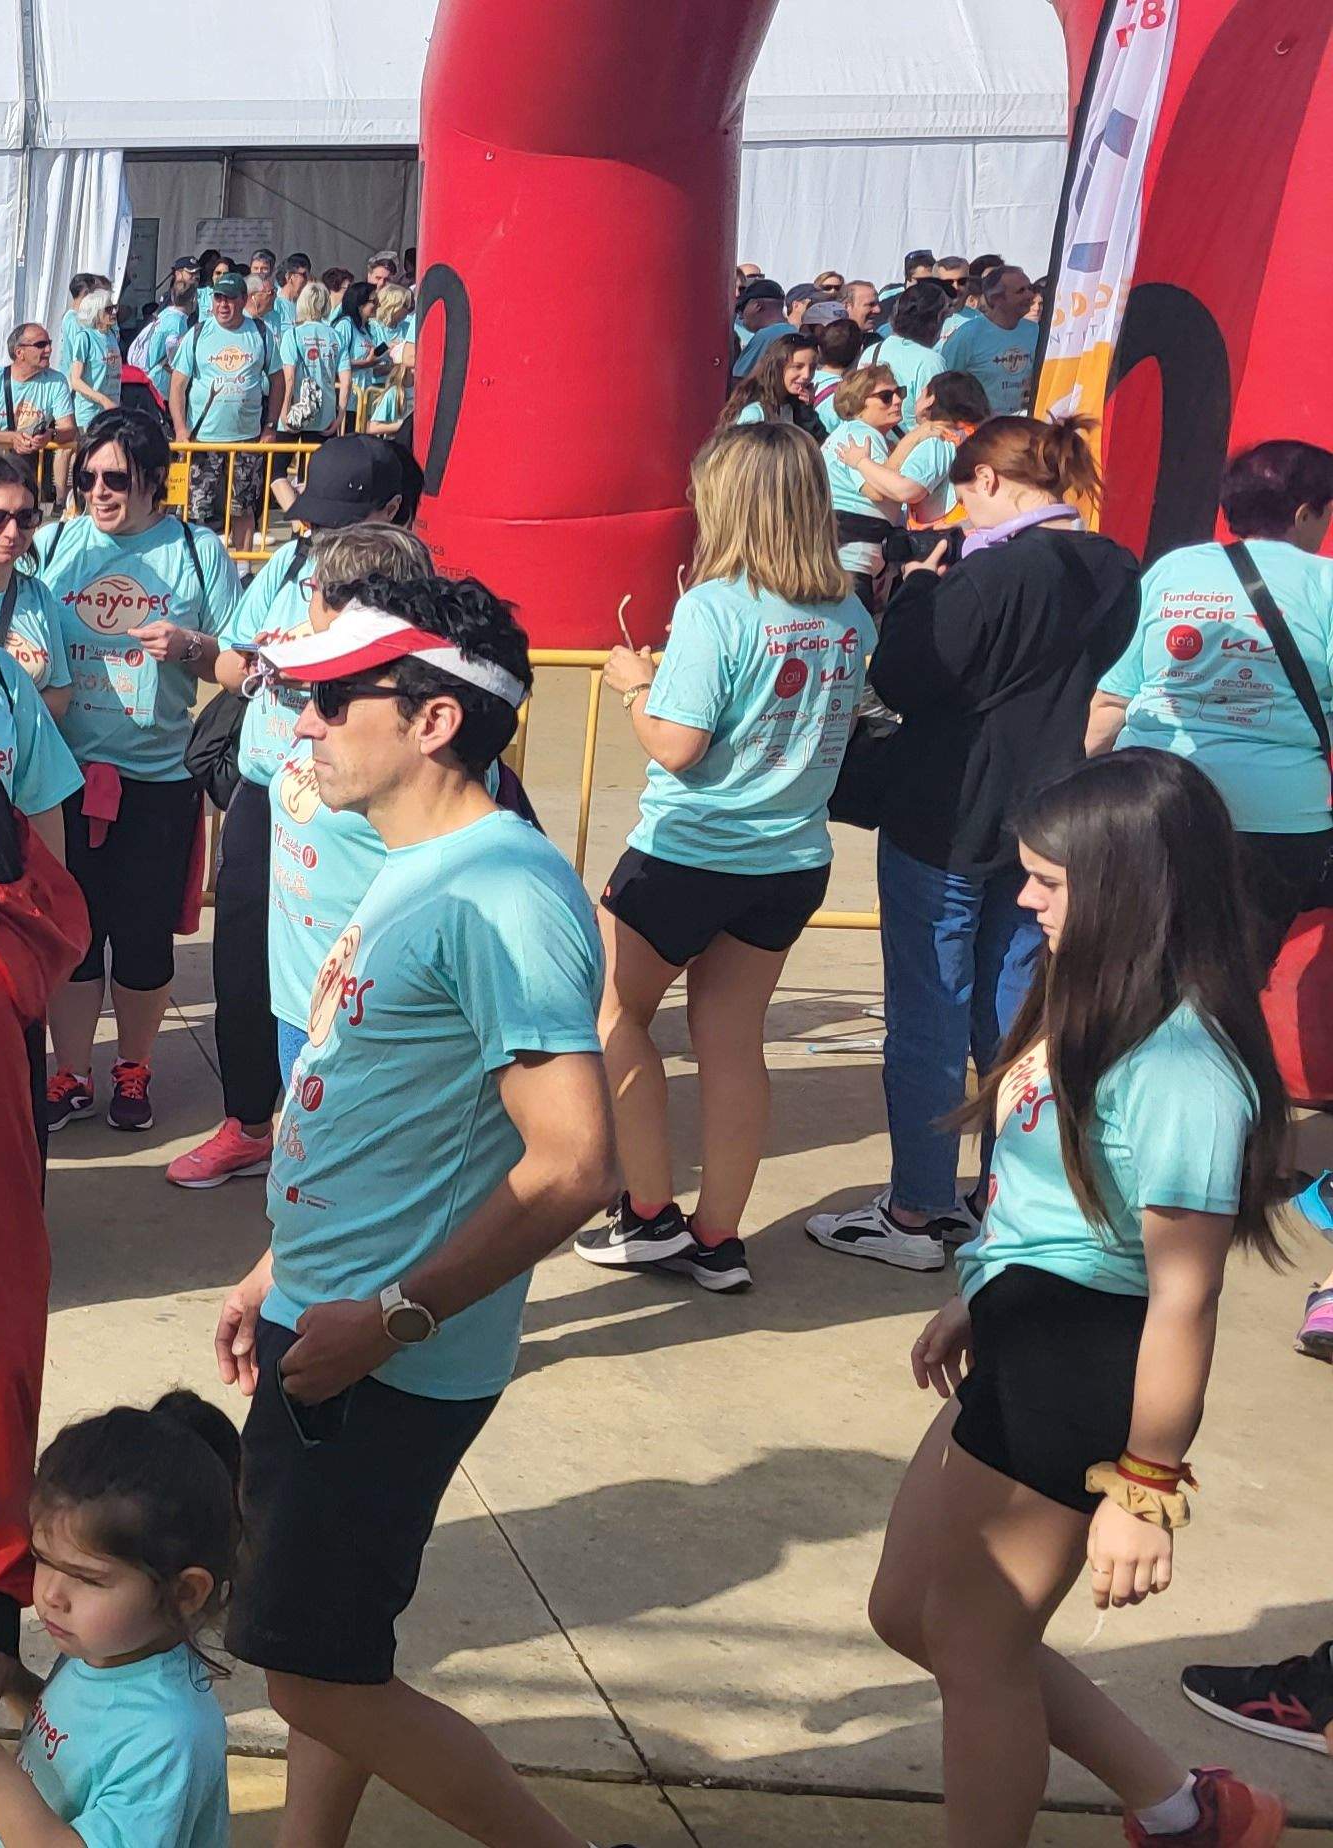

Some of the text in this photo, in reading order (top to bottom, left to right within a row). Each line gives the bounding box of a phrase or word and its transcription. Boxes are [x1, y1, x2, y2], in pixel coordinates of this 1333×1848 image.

[60, 590, 172, 619] +mayores
[1163, 590, 1234, 603] Fundación
[1159, 606, 1236, 624] iberCaja
[764, 617, 825, 637] Fundación
[767, 634, 830, 657] iberCaja
